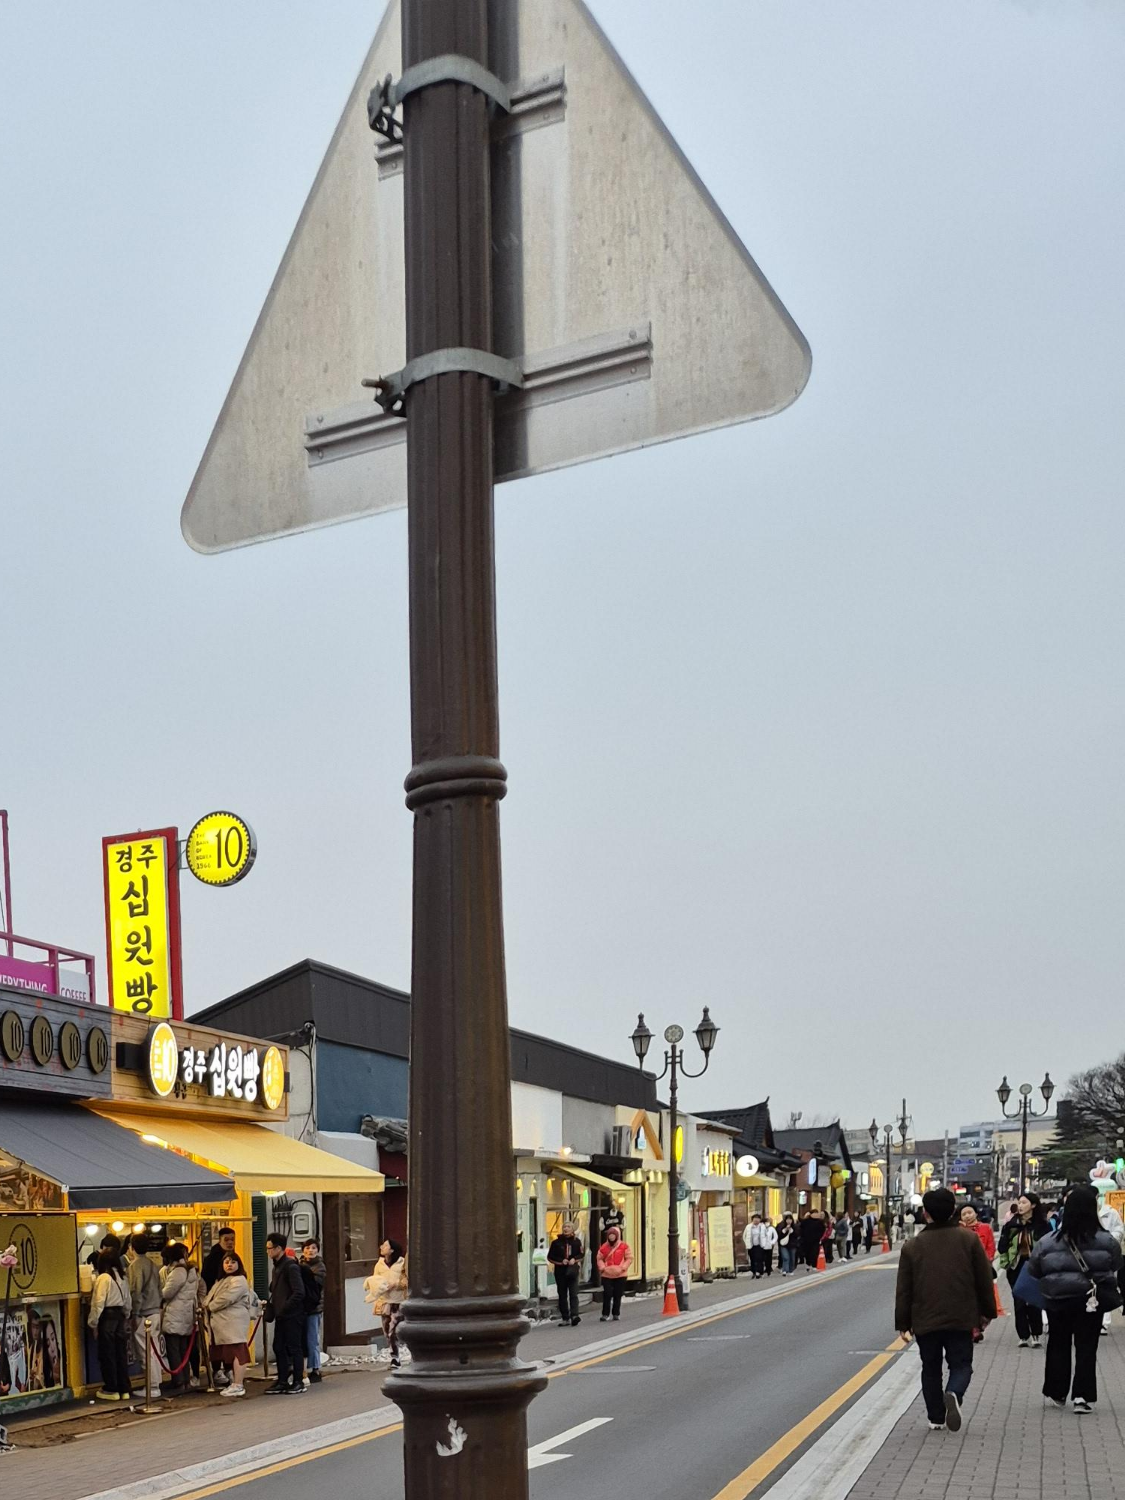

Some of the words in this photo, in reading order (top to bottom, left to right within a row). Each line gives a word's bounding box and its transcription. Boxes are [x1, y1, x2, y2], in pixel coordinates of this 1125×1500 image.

[115, 844, 158, 873] 경주
[215, 826, 243, 868] 10
[121, 874, 159, 1015] 십원빵
[10, 1020, 23, 1052] 10
[40, 1026, 52, 1057] 10
[69, 1031, 81, 1061] 10
[96, 1037, 107, 1066] 10
[182, 1046, 207, 1083] 경주
[210, 1042, 260, 1102] 십원빵
[20, 1237, 34, 1276] 10
